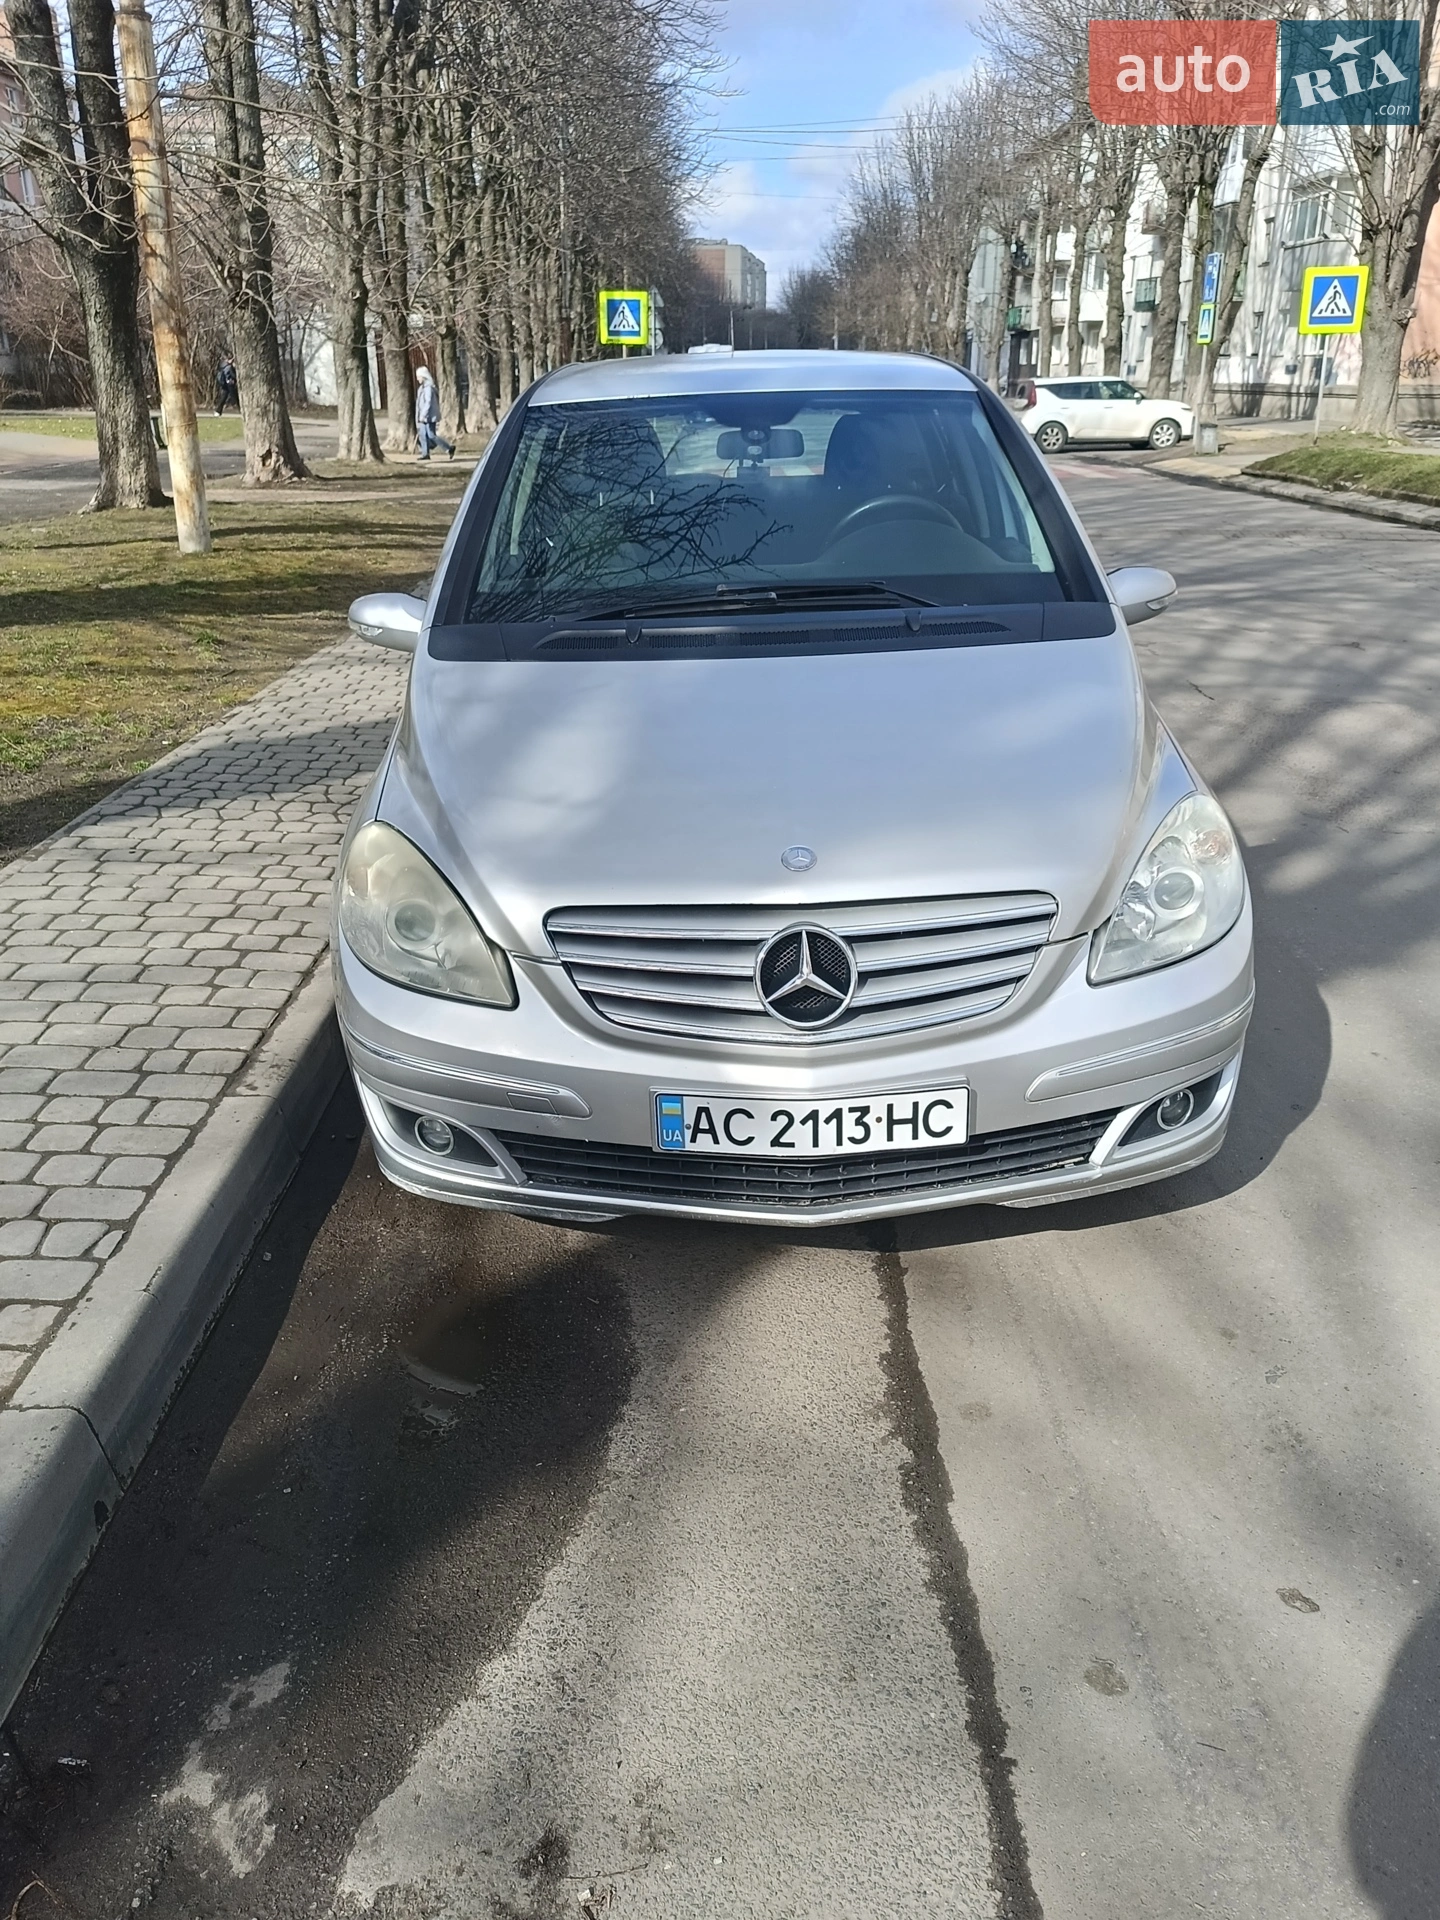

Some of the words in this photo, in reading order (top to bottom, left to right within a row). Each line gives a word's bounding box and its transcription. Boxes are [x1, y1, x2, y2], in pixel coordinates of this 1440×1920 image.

[663, 1129, 683, 1143] UA
[690, 1106, 755, 1146] AC
[770, 1105, 872, 1148] 2113
[886, 1099, 954, 1142] HC
